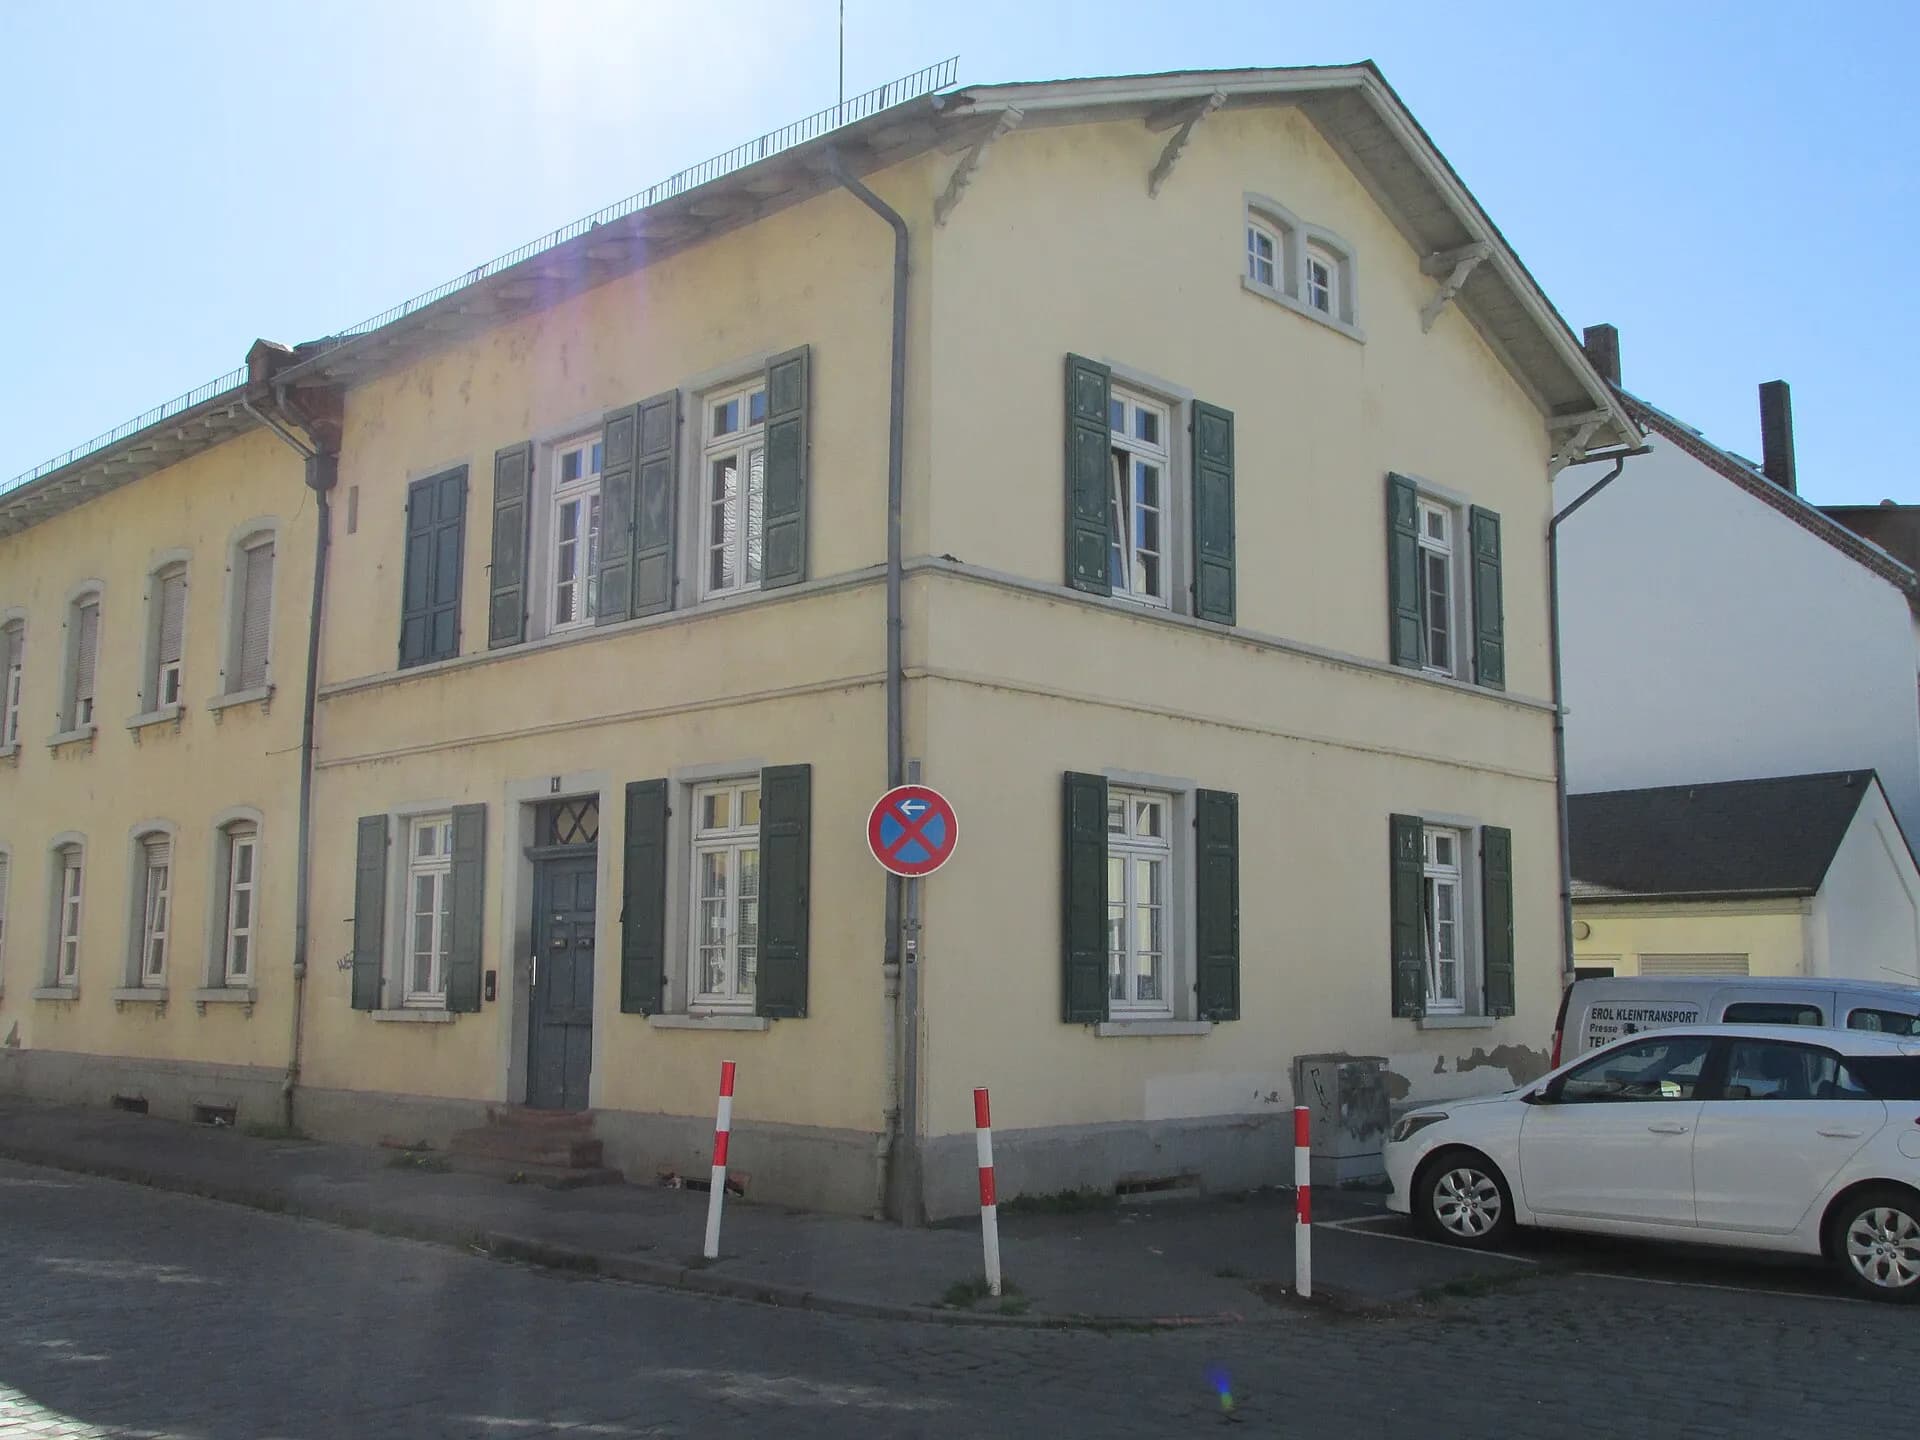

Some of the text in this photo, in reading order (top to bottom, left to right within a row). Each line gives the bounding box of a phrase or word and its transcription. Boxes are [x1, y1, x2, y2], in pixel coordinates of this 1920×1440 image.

[1591, 1008, 1698, 1024] EROL KLEINTRANSPORT
[1589, 1023, 1618, 1034] Presse
